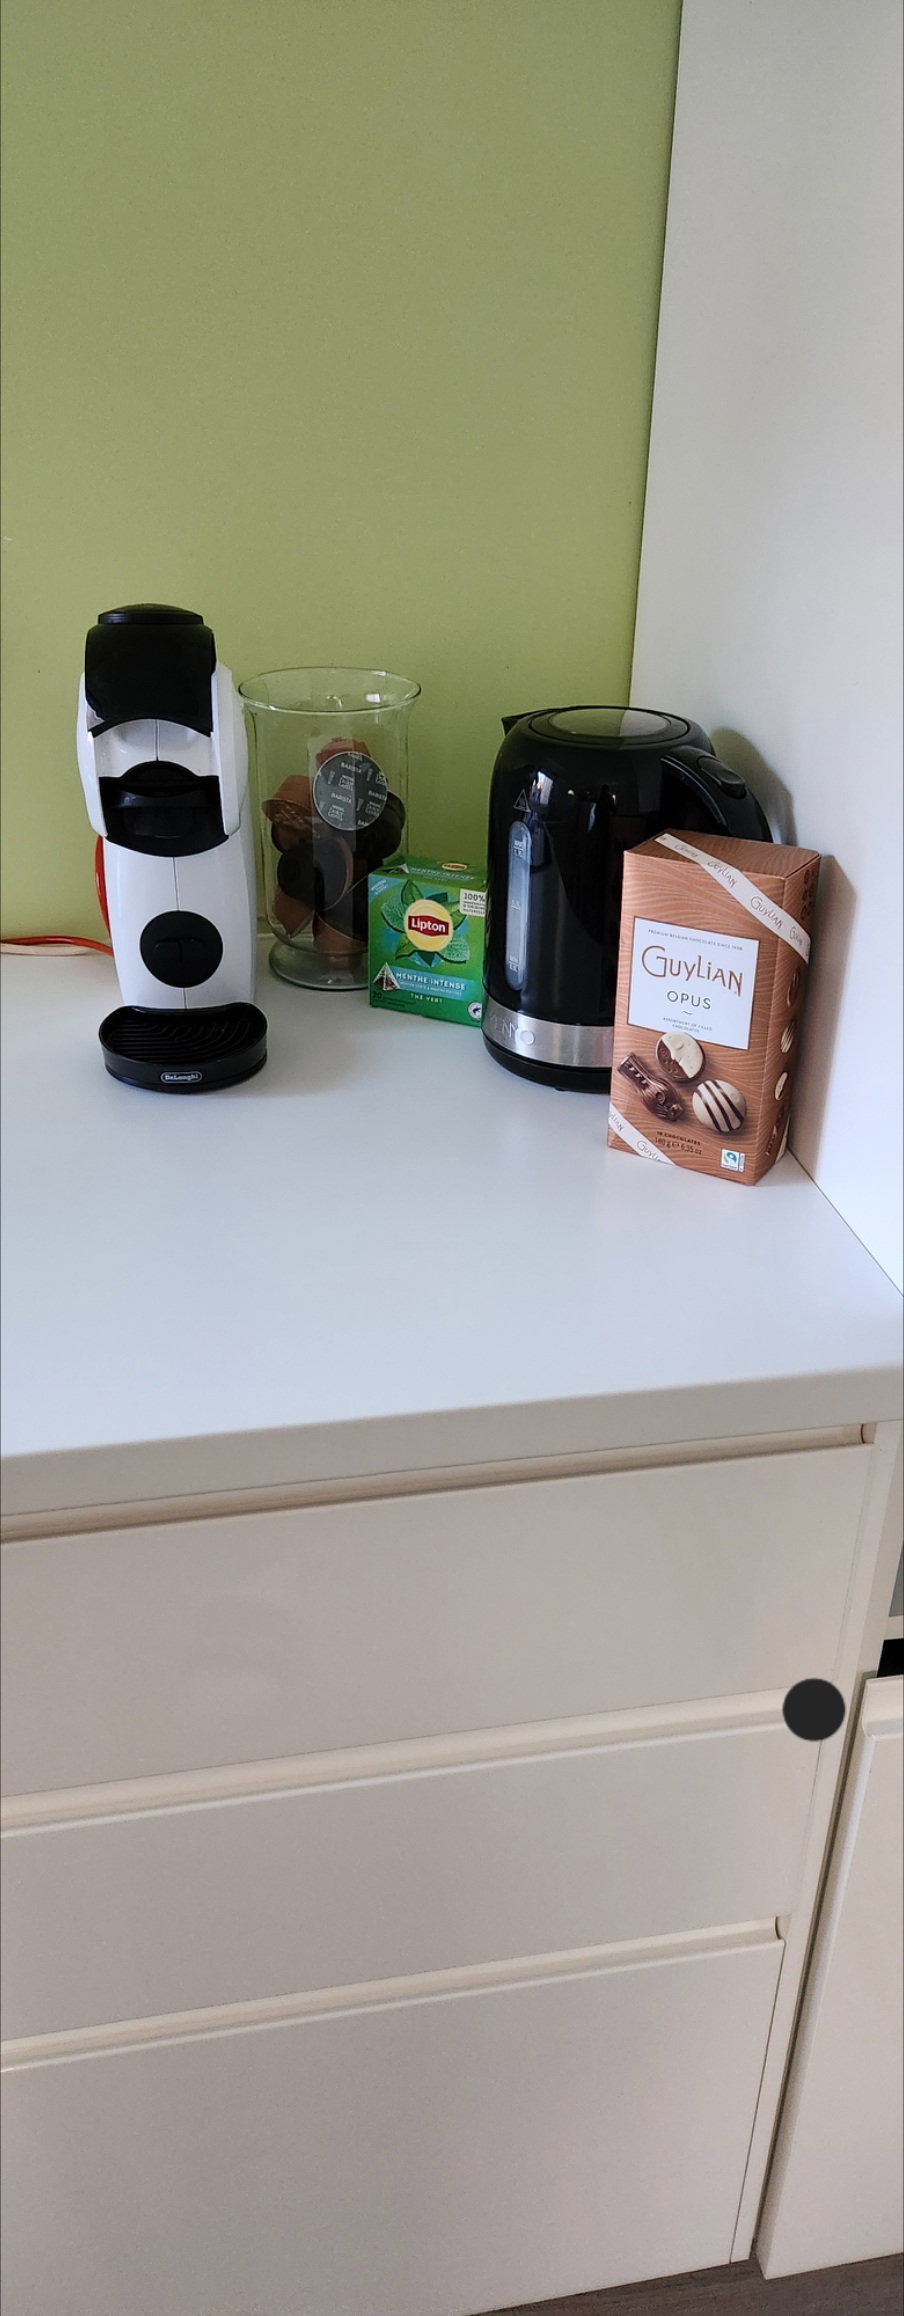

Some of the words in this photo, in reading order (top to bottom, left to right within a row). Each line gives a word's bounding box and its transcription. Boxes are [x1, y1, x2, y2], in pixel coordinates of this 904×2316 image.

[410, 917, 446, 933] Lipton
[396, 972, 428, 984] MENTHE
[430, 979, 465, 990] INTENSE
[666, 990, 712, 1010] OPUS
